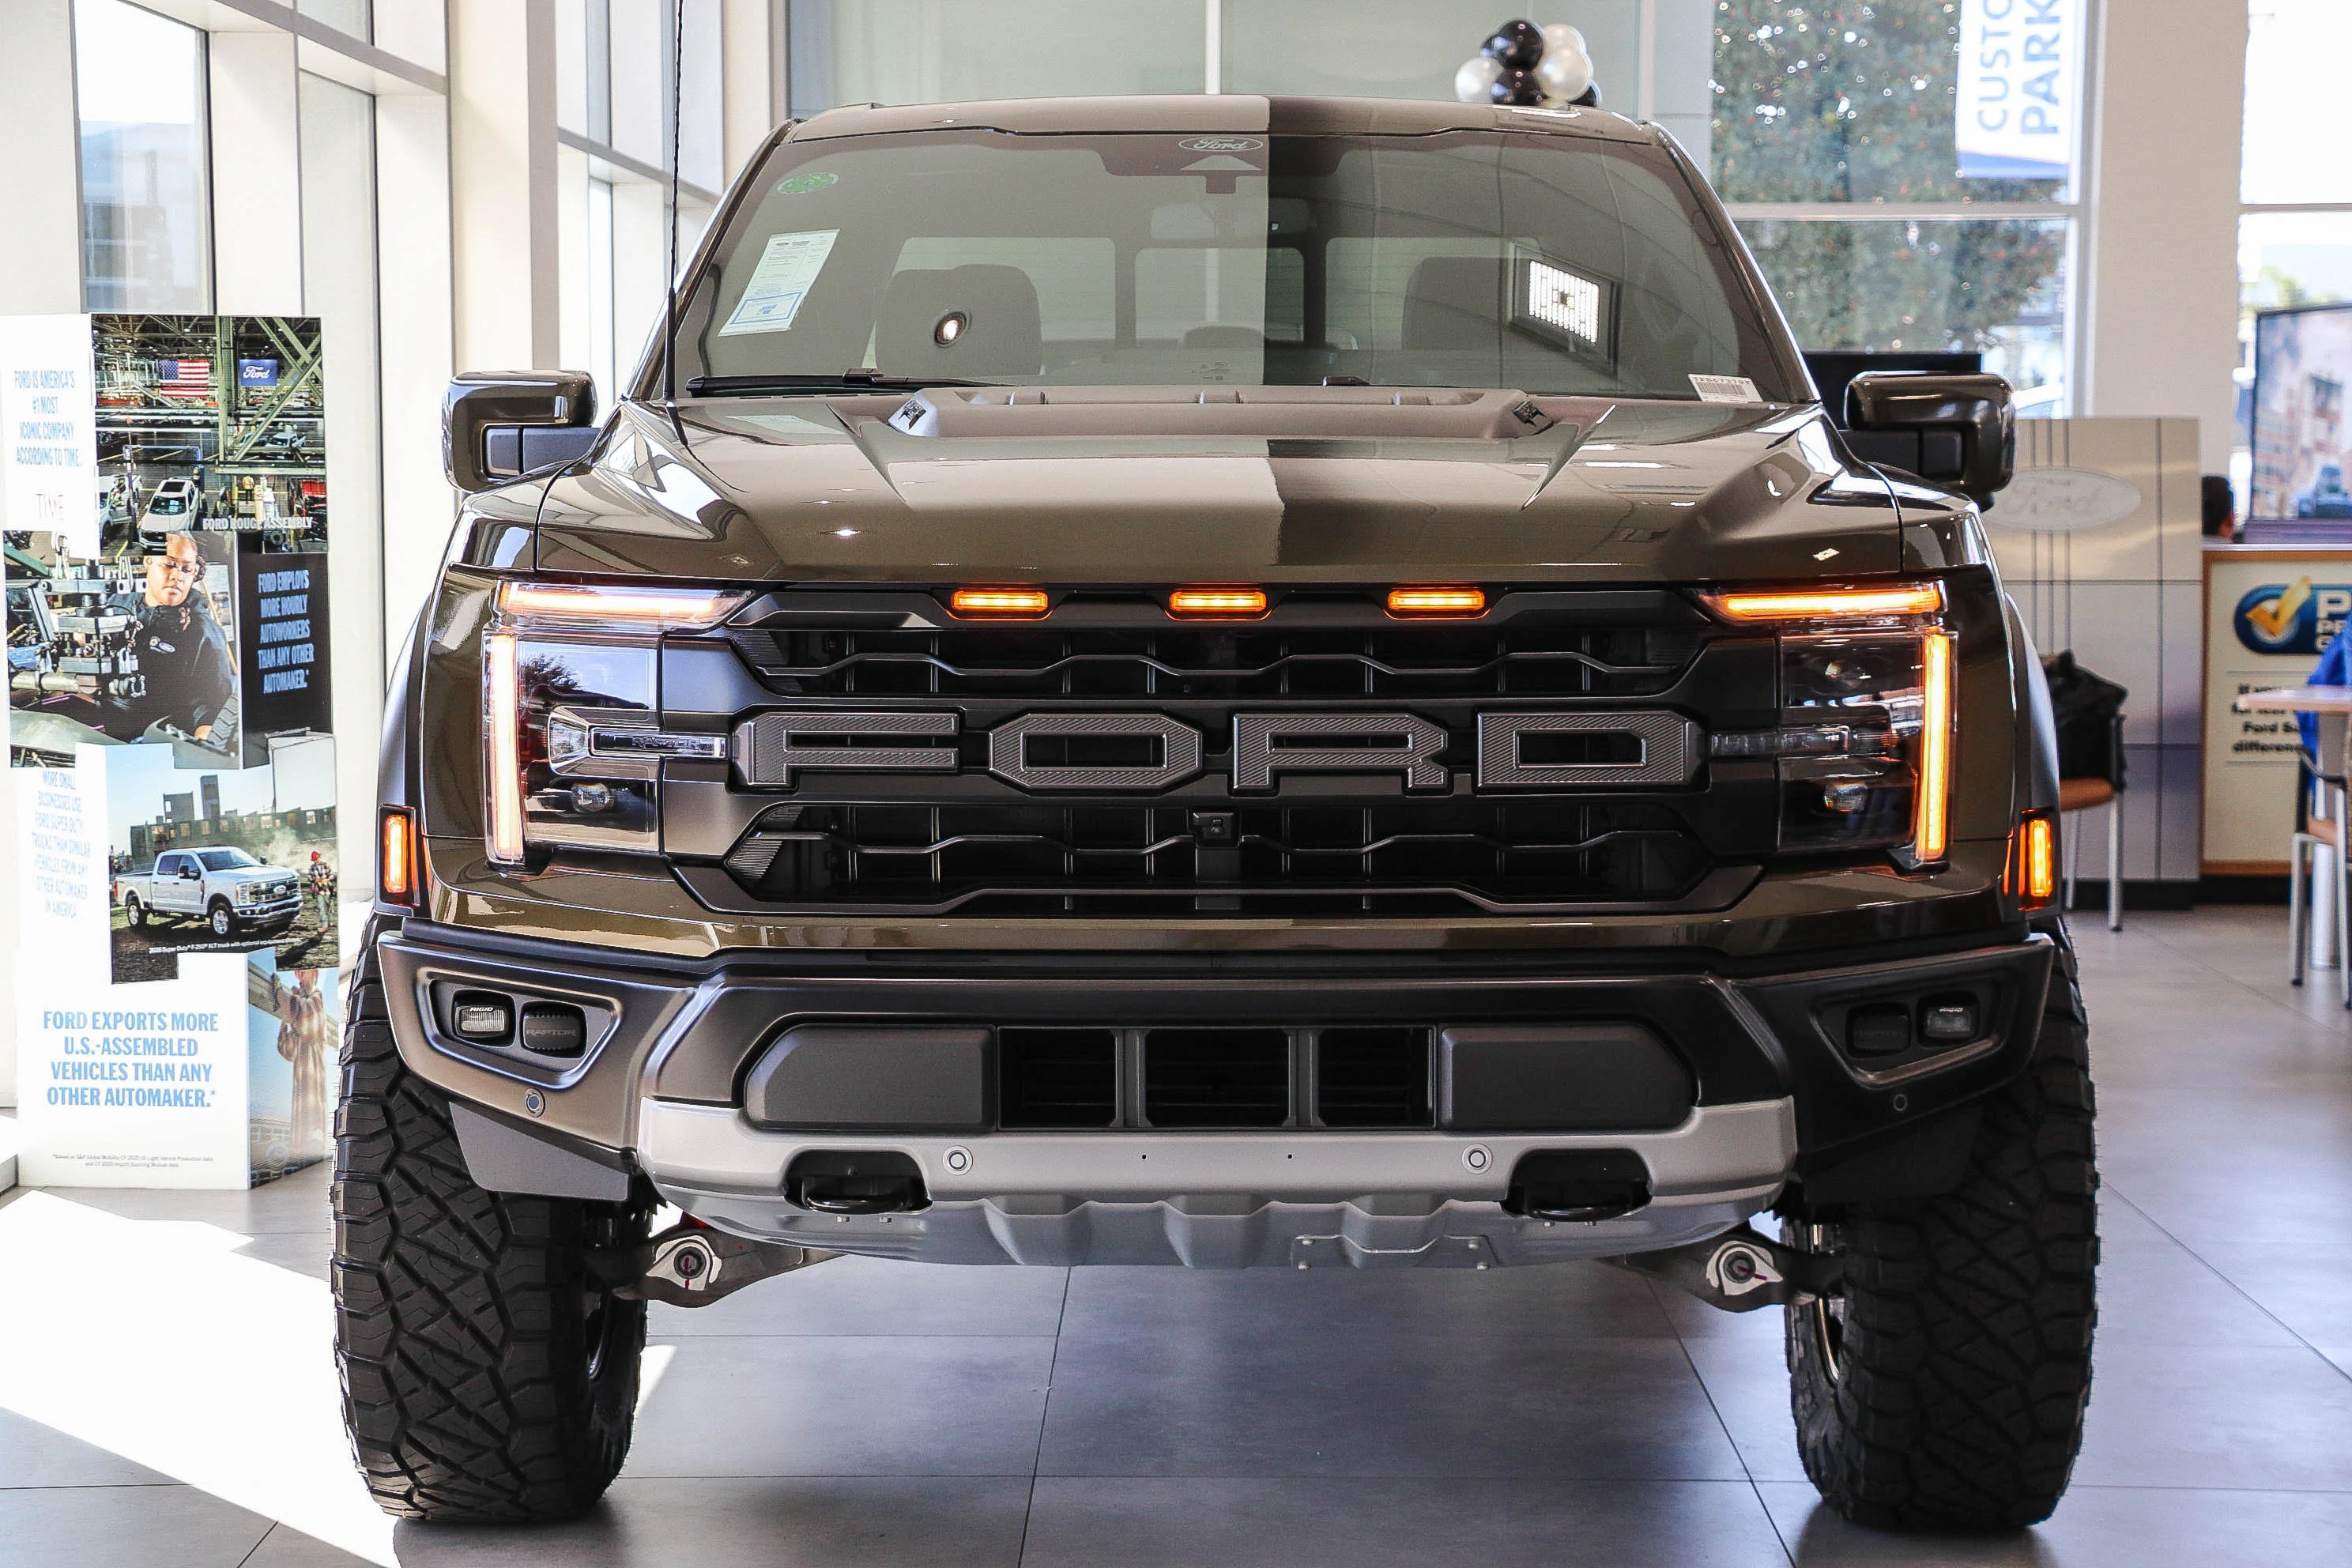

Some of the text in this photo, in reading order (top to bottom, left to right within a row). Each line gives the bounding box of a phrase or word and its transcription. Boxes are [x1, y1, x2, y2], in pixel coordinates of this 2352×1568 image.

[1193, 138, 1248, 149] Ford
[243, 365, 270, 379] Ford
[202, 518, 228, 530] FORD
[262, 516, 314, 529] ASSEMBLY
[277, 569, 310, 592] EMPLOYS
[291, 643, 315, 665] OTHER
[739, 711, 1691, 792] FORD
[43, 1011, 219, 1031] FORD EXPORTS MORE
[64, 1036, 198, 1057] U.S.-ASSEMBLED
[51, 1061, 213, 1082] VEHICLES THAN ANY
[47, 1086, 100, 1106] OTHER
